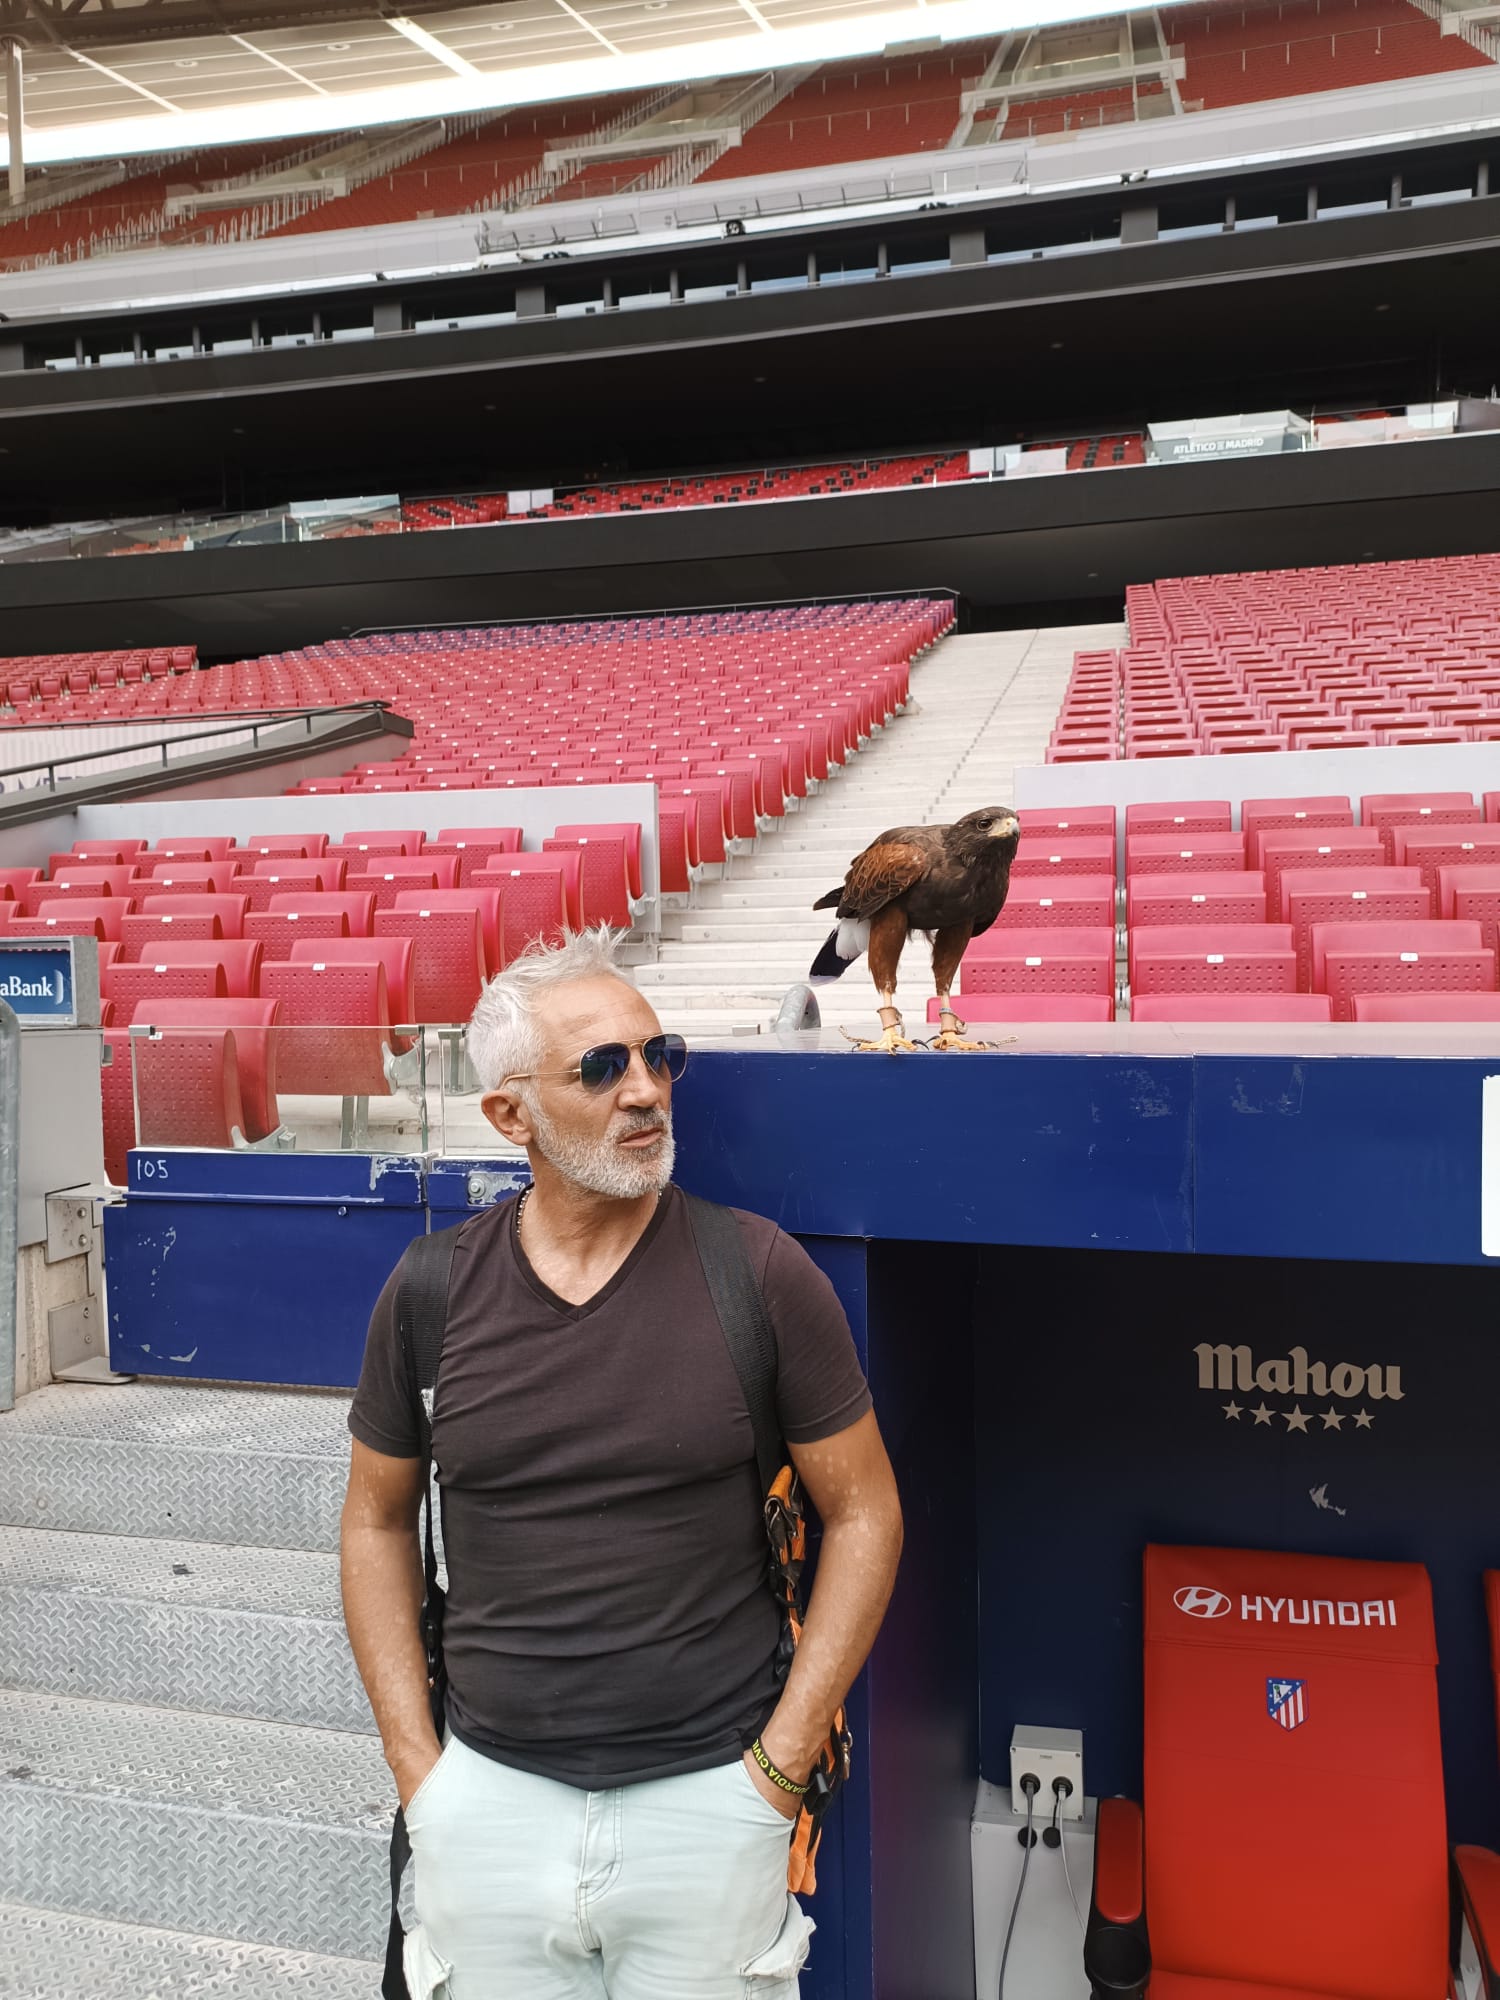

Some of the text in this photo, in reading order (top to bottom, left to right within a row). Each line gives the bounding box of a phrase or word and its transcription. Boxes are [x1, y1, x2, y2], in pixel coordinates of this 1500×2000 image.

[1225, 438, 1264, 449] MADRID
[137, 1159, 169, 1181] 105
[1240, 1594, 1397, 1626] HYUNDAI
